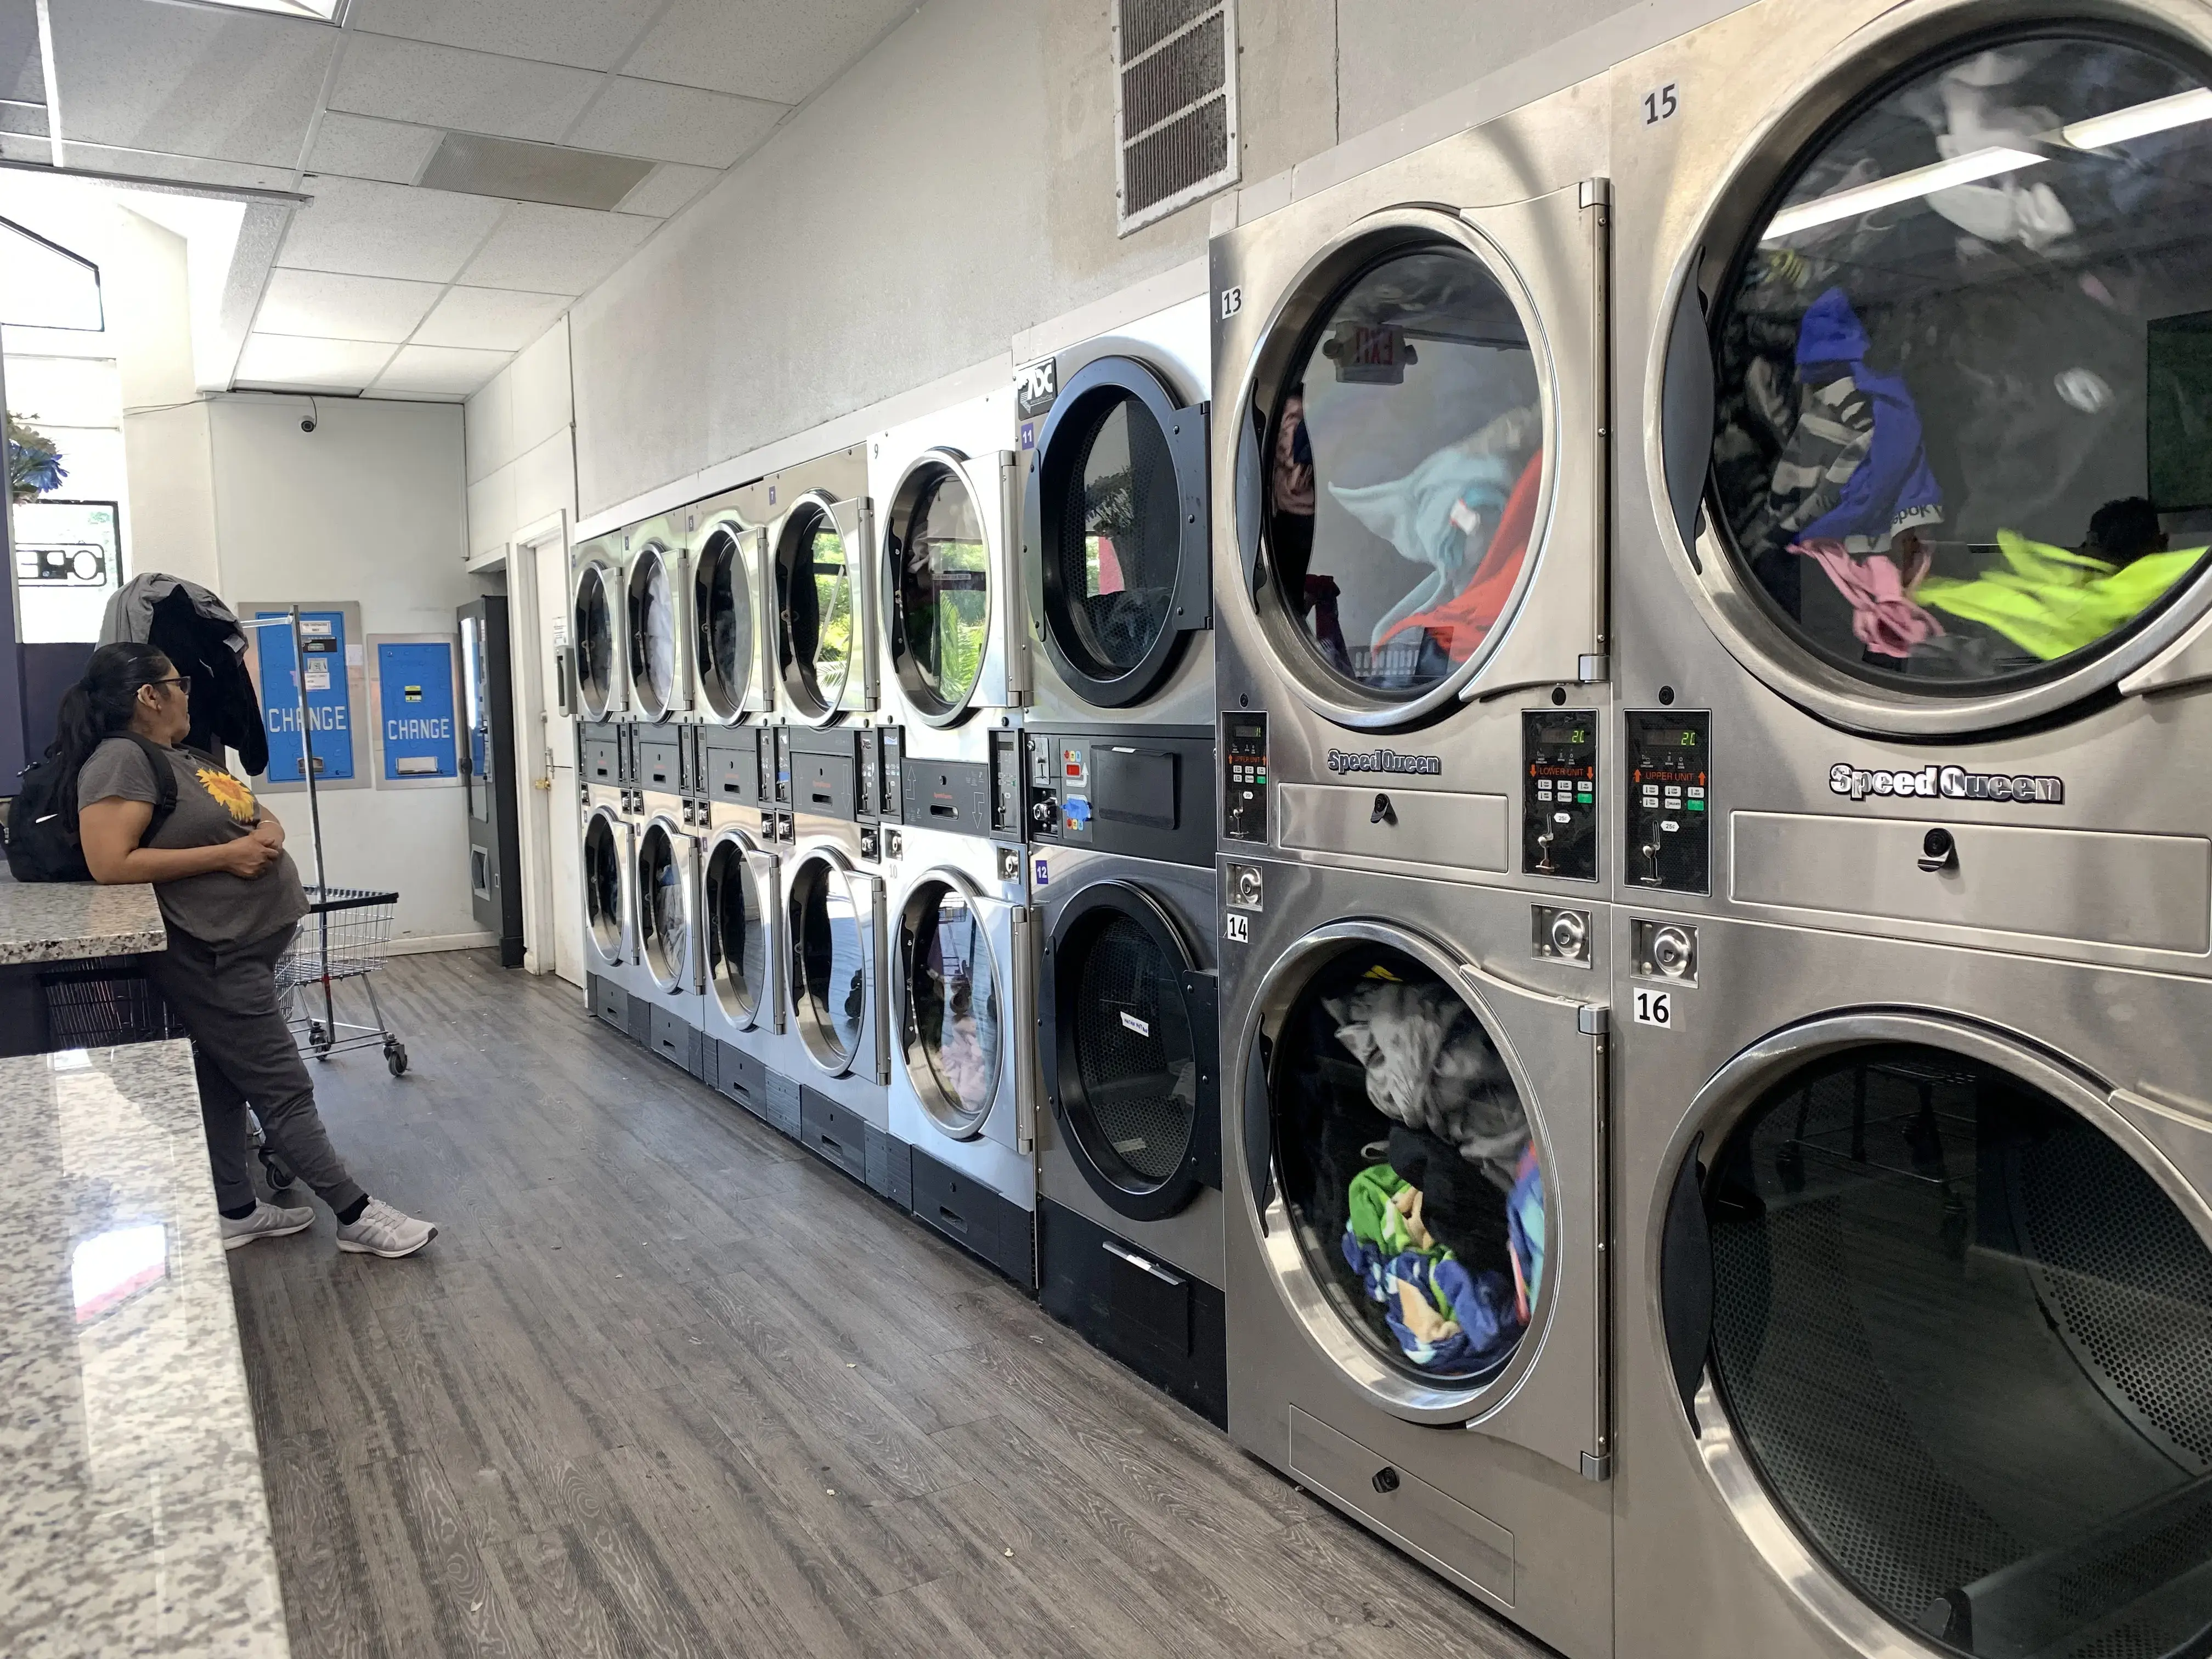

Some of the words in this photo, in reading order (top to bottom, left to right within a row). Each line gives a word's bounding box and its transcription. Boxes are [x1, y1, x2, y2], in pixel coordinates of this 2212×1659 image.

[1645, 83, 1677, 125] 15
[1224, 288, 1242, 315] 13
[1023, 429, 1032, 443] 11
[874, 443, 879, 459] 9
[770, 490, 775, 500] 7
[388, 719, 450, 740] CHANGE
[1328, 748, 1383, 775] Speed
[1382, 749, 1442, 775] Queen
[1540, 767, 1565, 775] LOWER
[1646, 771, 1672, 780] UPPER
[1675, 772, 1694, 781] UNIT
[1829, 763, 1940, 802] Speed
[1939, 765, 2065, 804] Queen
[889, 864, 898, 879] 10
[1037, 866, 1047, 878] 12
[1229, 917, 1248, 940] 14
[1637, 993, 1669, 1023] 16
